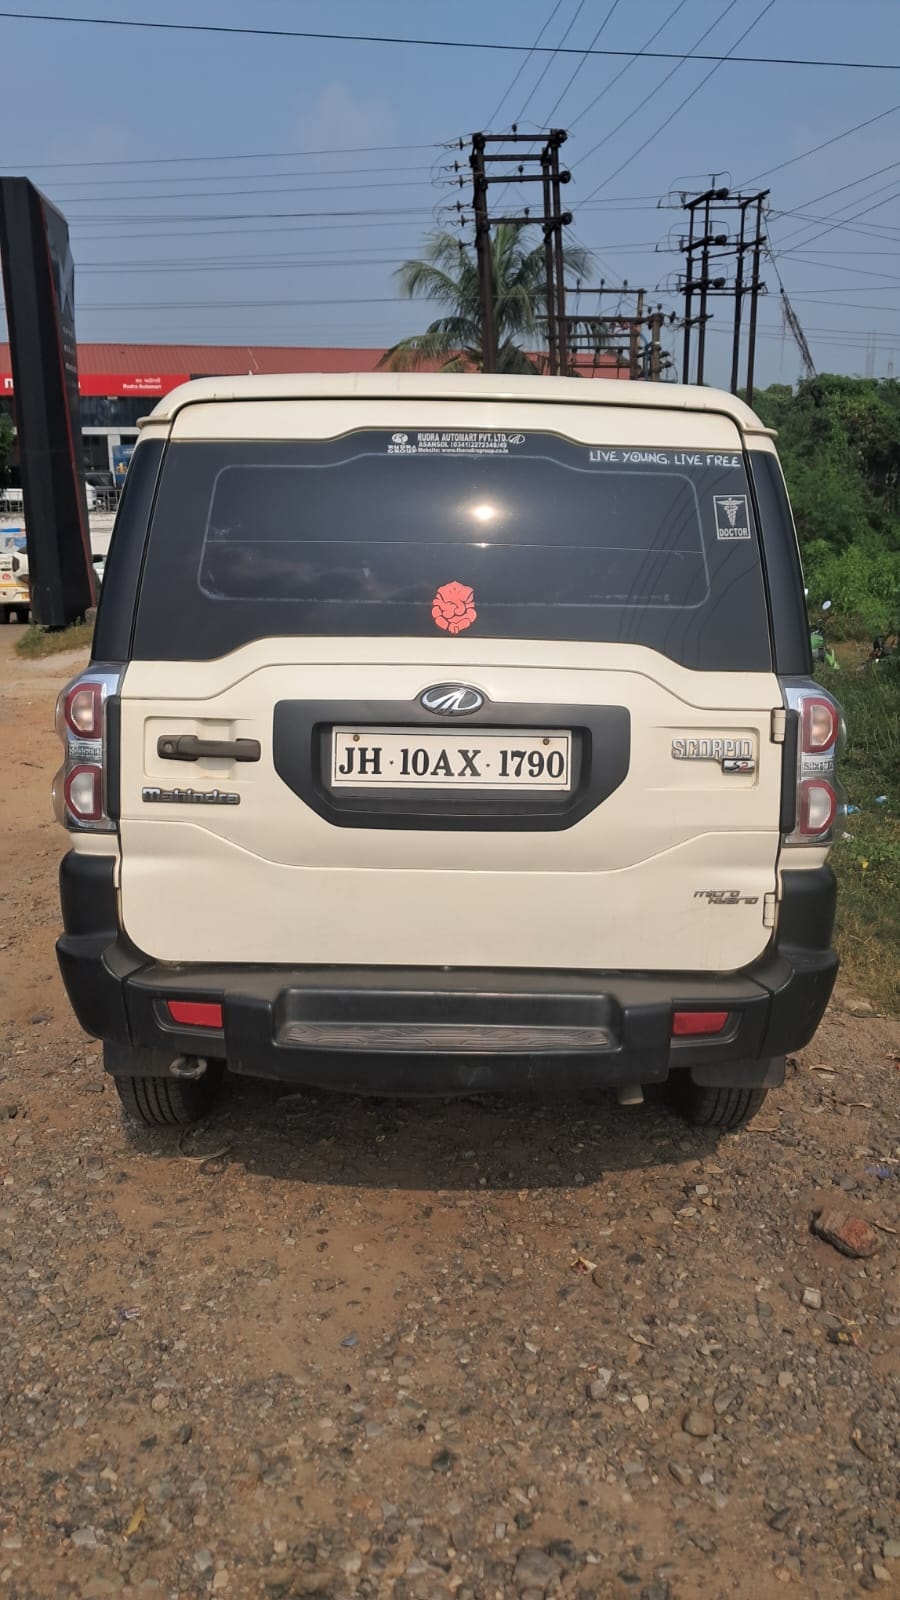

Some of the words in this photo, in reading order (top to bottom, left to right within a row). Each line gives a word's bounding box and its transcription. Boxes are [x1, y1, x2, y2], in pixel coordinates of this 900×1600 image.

[417, 432, 440, 441] RUDRA
[441, 433, 477, 442] AUTOMART
[589, 450, 619, 462] LIVE
[674, 453, 703, 465] LIVE
[705, 454, 741, 467] FREE
[718, 528, 748, 537] DOCTOR
[671, 739, 753, 759] SCORPIO
